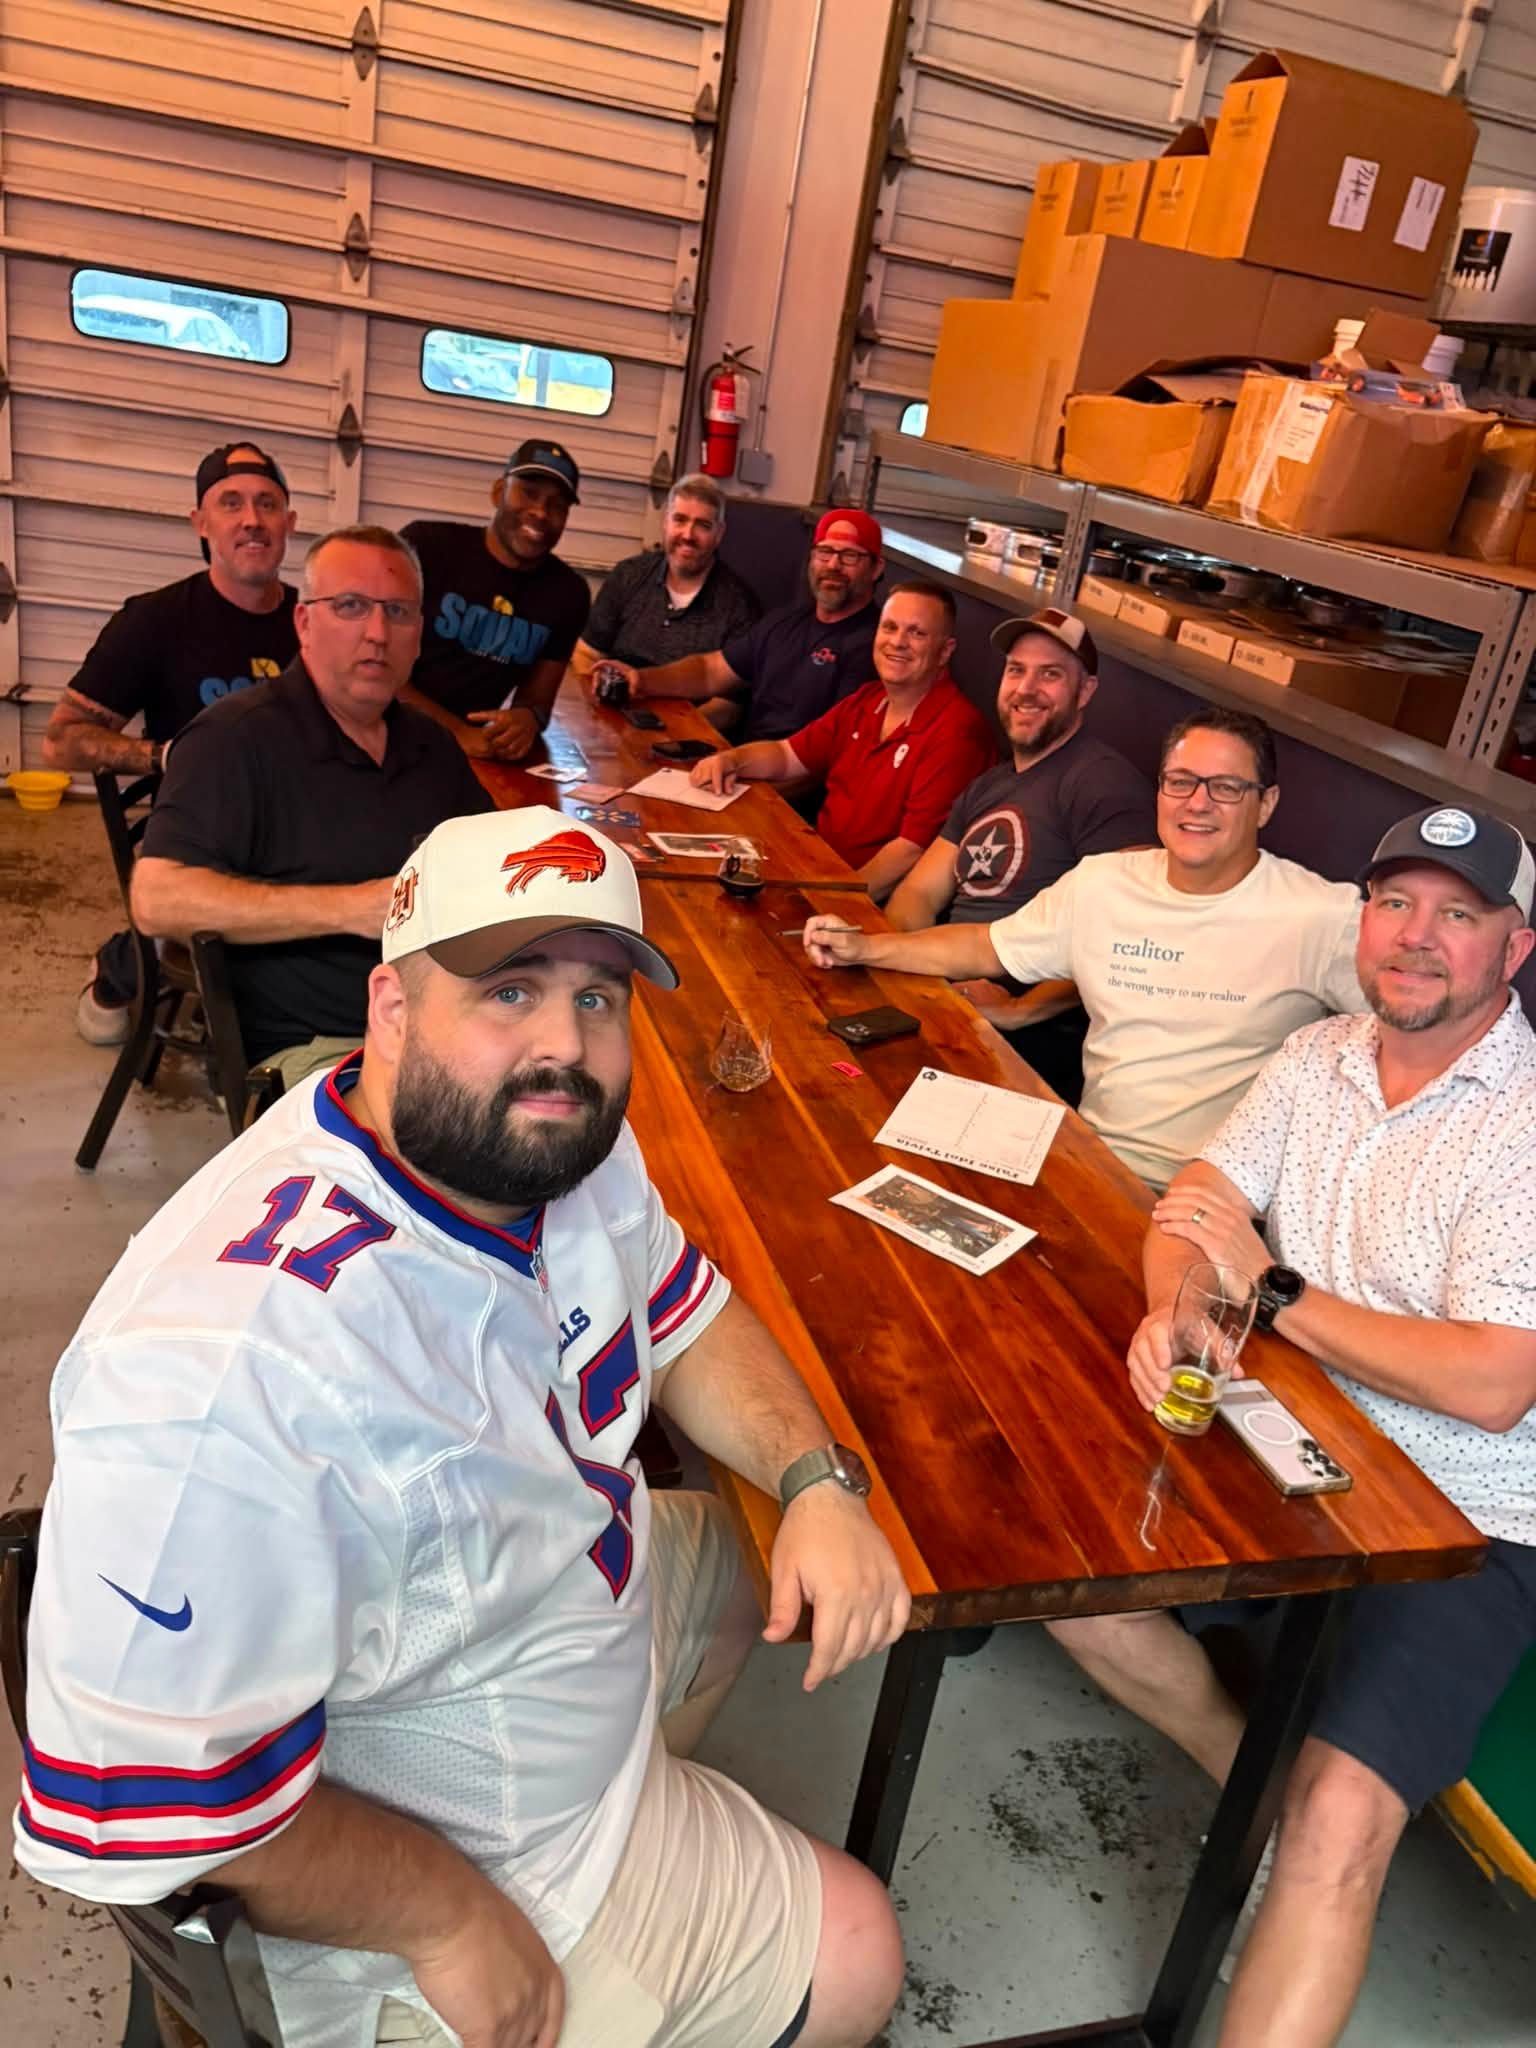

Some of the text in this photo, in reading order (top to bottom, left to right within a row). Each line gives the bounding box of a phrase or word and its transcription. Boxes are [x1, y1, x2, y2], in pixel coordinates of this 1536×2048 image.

[1112, 937, 1184, 962] realitor
[1108, 976, 1247, 1003] the wrong way to say realtor
[896, 1137, 943, 1157] Trivia
[217, 1175, 398, 1294] 17
